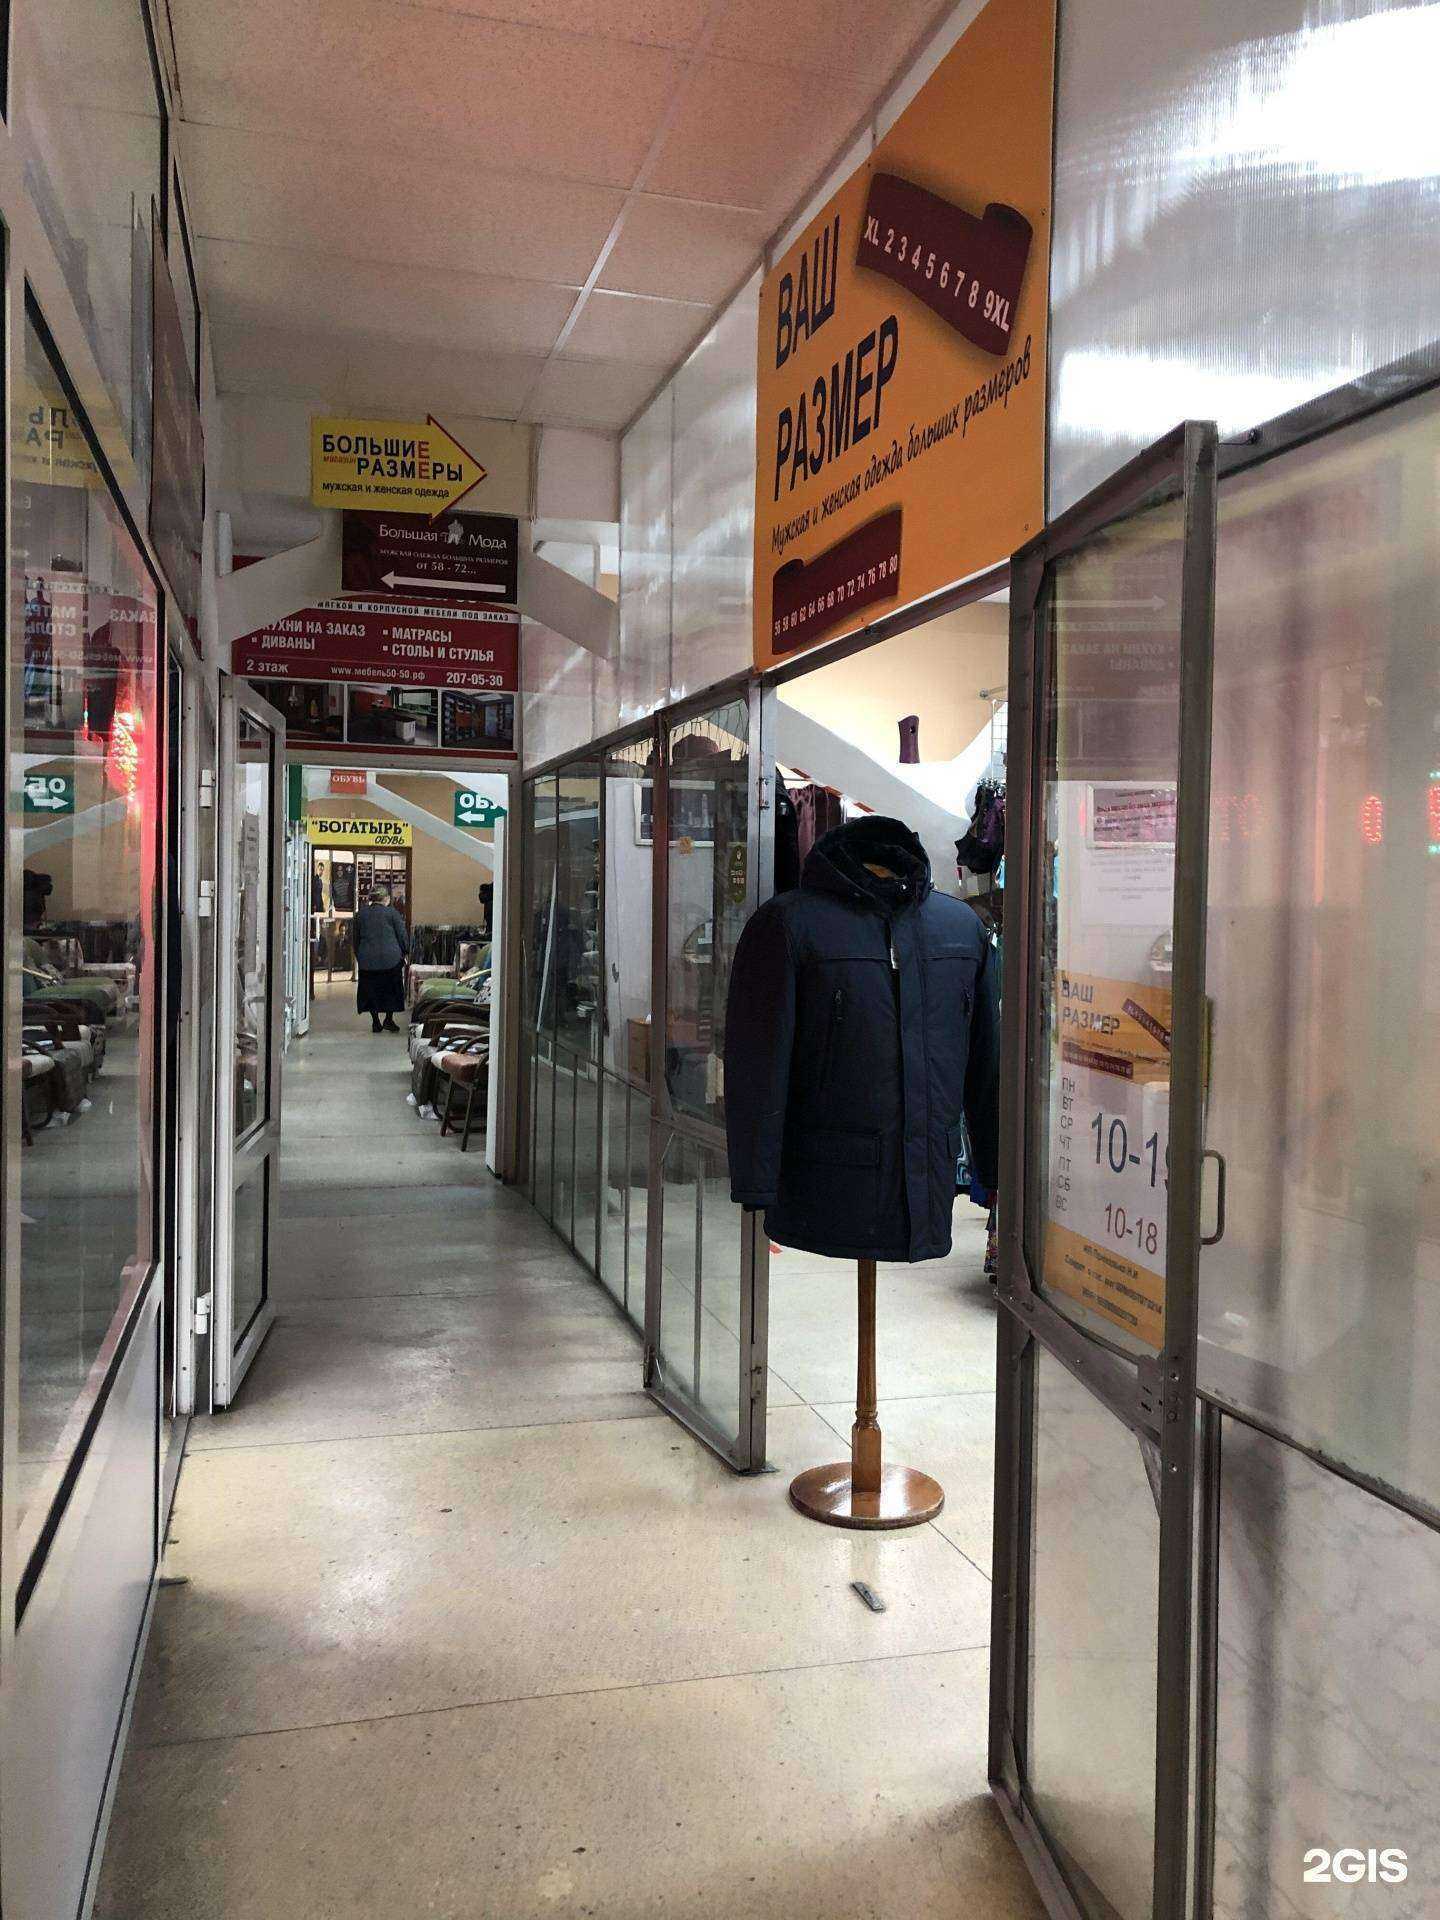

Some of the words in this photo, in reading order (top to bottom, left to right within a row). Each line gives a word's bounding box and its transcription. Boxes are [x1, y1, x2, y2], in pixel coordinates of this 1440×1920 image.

[864, 216, 879, 246] XL
[884, 229, 894, 254] 2
[898, 236, 907, 261] 3
[912, 245, 921, 270] 4
[926, 253, 936, 279] 5
[940, 262, 949, 288] 6
[955, 270, 965, 297] 7
[968, 280, 979, 308] 8
[983, 290, 1009, 332] 9XL
[776, 215, 840, 370] ВАШ
[774, 314, 898, 501] РАЗМЕР
[322, 434, 430, 460] БОЛЬШИЕ
[772, 510, 810, 555] Мужская
[813, 507, 819, 525] и
[821, 474, 861, 520] женская
[864, 440, 902, 491] одежда
[908, 404, 959, 461] больших
[963, 334, 1031, 438] размеров
[357, 457, 463, 482] РАЗМЕРЫ
[322, 483, 363, 495] мужская
[373, 485, 413, 496] женская
[415, 488, 450, 499] одежда
[380, 524, 438, 542] Большая
[468, 534, 507, 550] Мода
[431, 562, 444, 571] 58
[774, 620, 781, 636] 56
[782, 617, 789, 632] 58
[790, 610, 798, 628] 60
[799, 606, 807, 623] 62
[808, 601, 815, 618] 64
[817, 596, 825, 613] 66
[827, 590, 835, 608] 68
[837, 586, 845, 603] 70
[847, 579, 855, 598] 72
[857, 573, 865, 592] 74
[868, 567, 876, 586] 76
[878, 561, 886, 580] 78
[889, 554, 898, 574] 80
[357, 603, 363, 611] И
[367, 604, 419, 616] КОРПУСНОЙ
[424, 607, 458, 618] МЕБЕЛИ
[462, 611, 479, 619] ПОД
[483, 612, 509, 622] ЗАКАЗ
[307, 621, 322, 634] НА
[326, 622, 366, 637] ЗАКАЗ
[392, 627, 452, 643] МАТРАСЫ
[262, 635, 315, 650] ДИВАНЫ
[392, 644, 434, 658] СТОЛЫ
[438, 647, 446, 659] И
[449, 648, 494, 662] СТУЛЬЯ
[246, 659, 254, 671] 2
[258, 662, 289, 673] этаж
[446, 672, 503, 686] 207-05-30
[332, 775, 365, 785] ОБУВЬ
[375, 836, 405, 845] ОБУВЬ
[1061, 979, 1093, 1003] ВАШ
[1062, 1006, 1120, 1035] РАЗМЕР
[1062, 1077, 1075, 1093] ПН
[1062, 1096, 1073, 1111] ВТ
[1061, 1115, 1073, 1131] СР
[1059, 1134, 1072, 1150] ЧТ
[1091, 1112, 1169, 1190] 10-1
[1058, 1156, 1071, 1172] ПТ
[1056, 1175, 1070, 1191] СБ
[1105, 1202, 1158, 1255] 10-18
